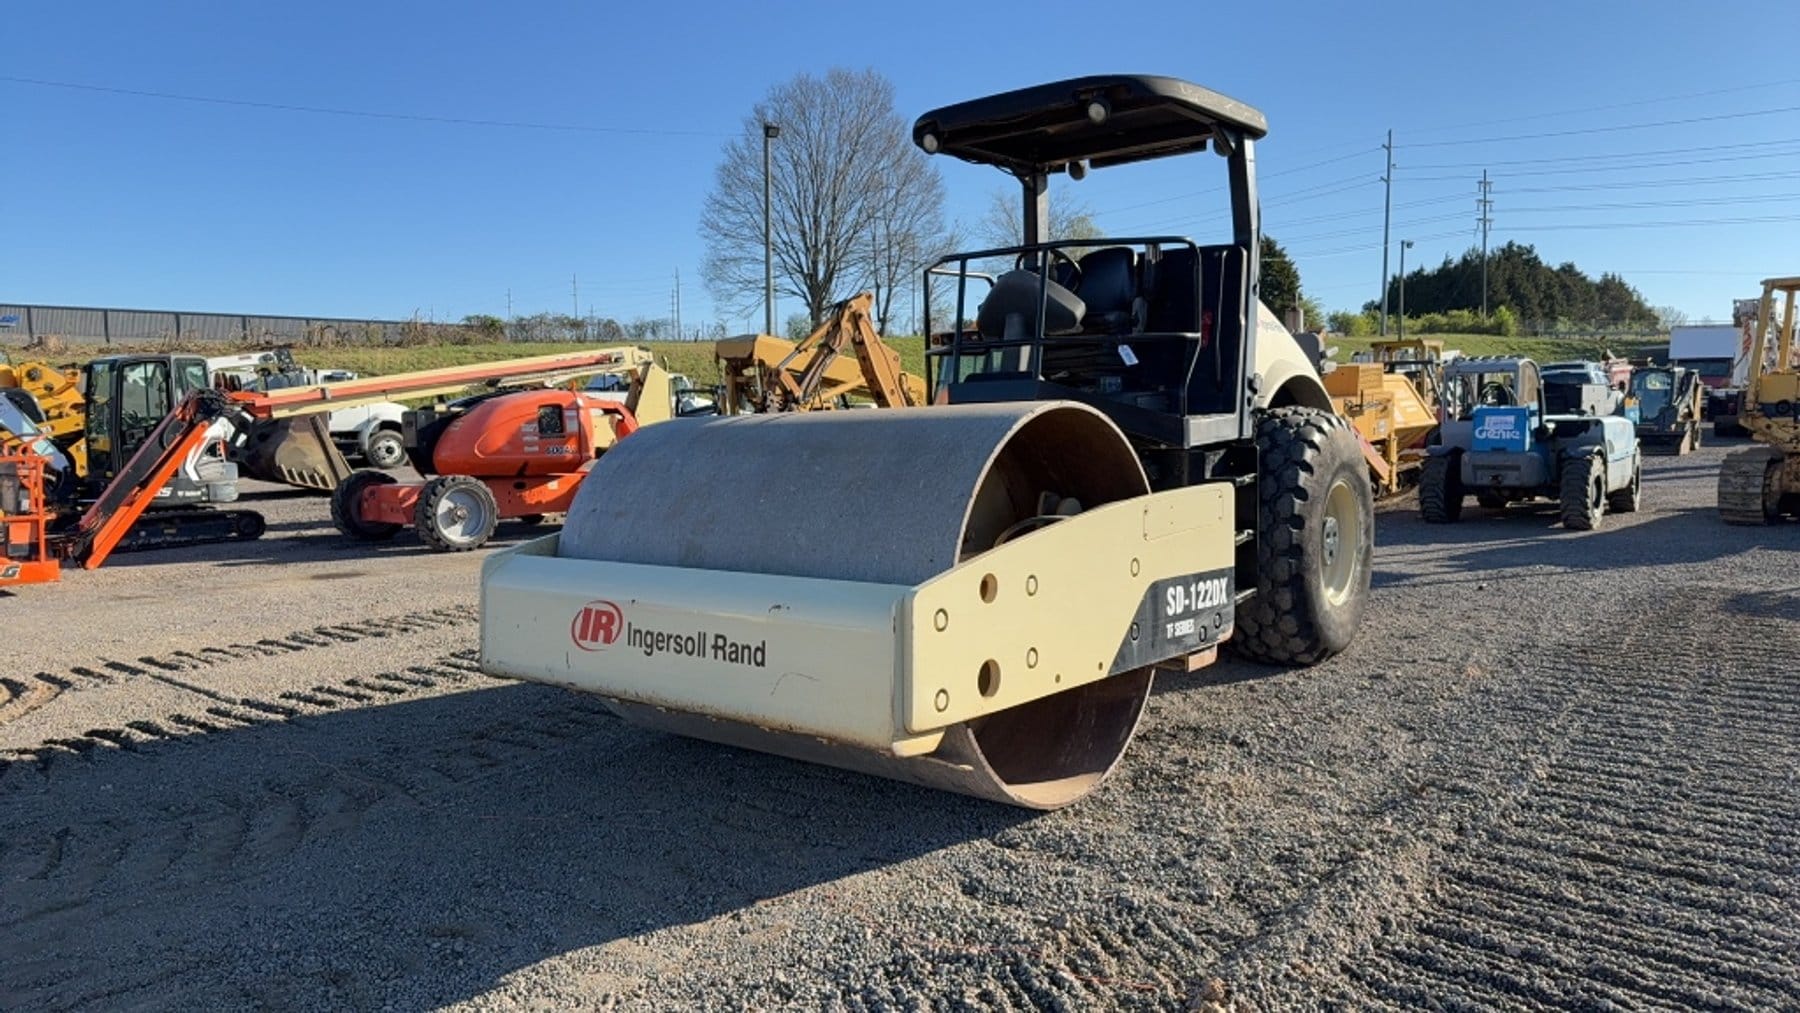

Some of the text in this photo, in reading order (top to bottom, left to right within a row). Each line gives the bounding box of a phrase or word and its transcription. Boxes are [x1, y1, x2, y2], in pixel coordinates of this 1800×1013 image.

[1475, 426, 1520, 440] Genie
[1166, 577, 1228, 616] SD-122DX
[578, 606, 616, 645] IR
[1174, 619, 1195, 637] SERIES
